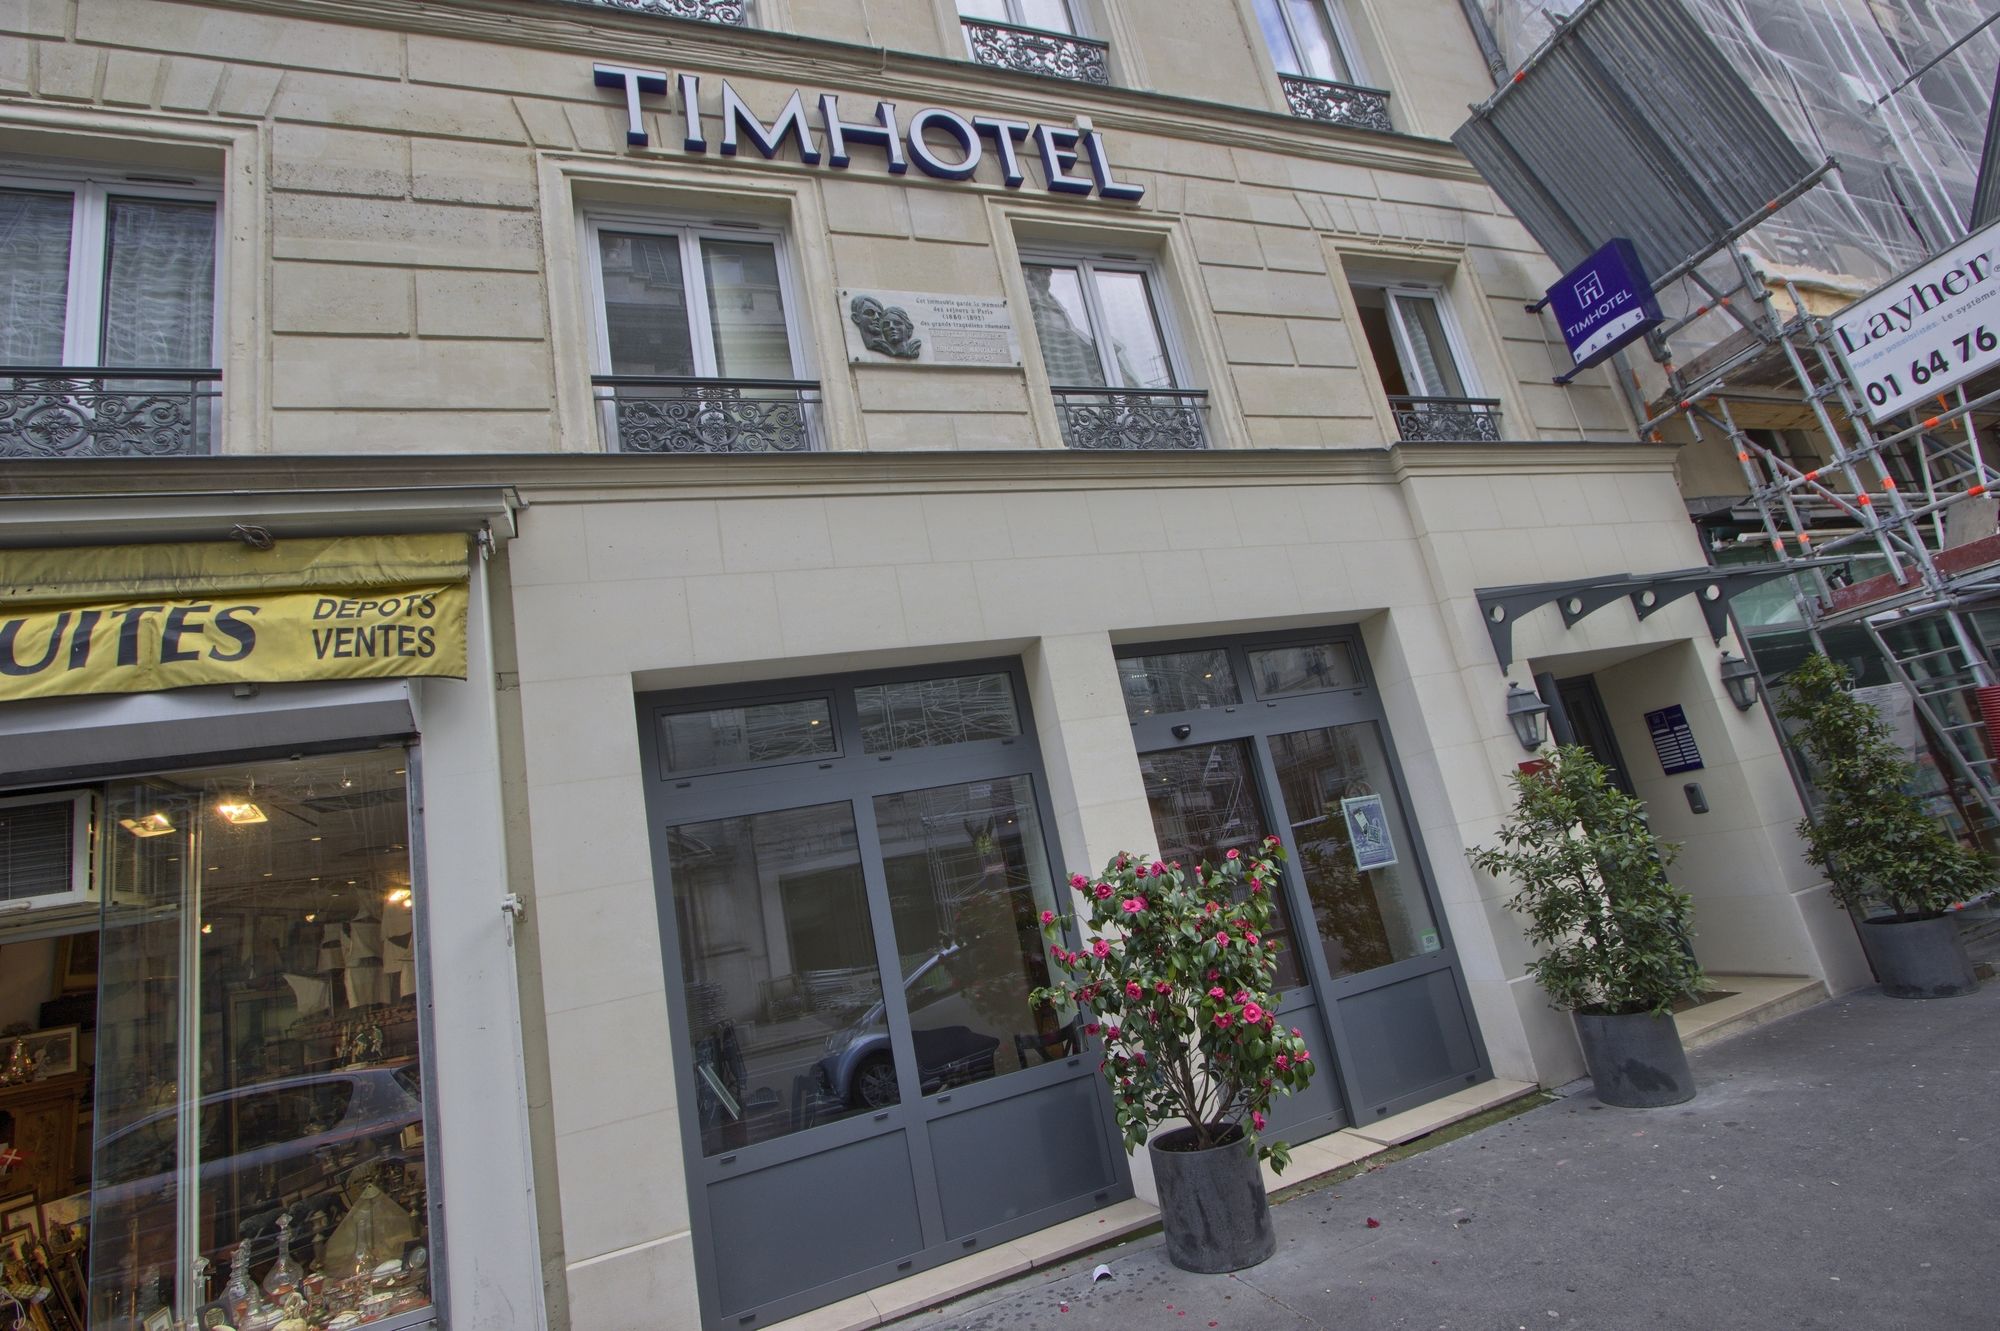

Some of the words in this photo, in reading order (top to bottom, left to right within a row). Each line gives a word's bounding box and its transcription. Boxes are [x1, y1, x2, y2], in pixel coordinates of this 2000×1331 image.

[593, 62, 1145, 201] TIMHOTEL
[1567, 289, 1633, 338] TIMHOTEL
[1834, 252, 1990, 356] Layher
[1942, 313, 1954, 322] Le
[1956, 289, 1997, 316] système
[1576, 312, 1642, 360] PARIS
[1866, 373, 1902, 407] 01
[1911, 349, 1950, 385] 64
[1952, 324, 1998, 364] 76
[0, 599, 261, 677] UITÉS
[312, 624, 436, 660] VENTES
